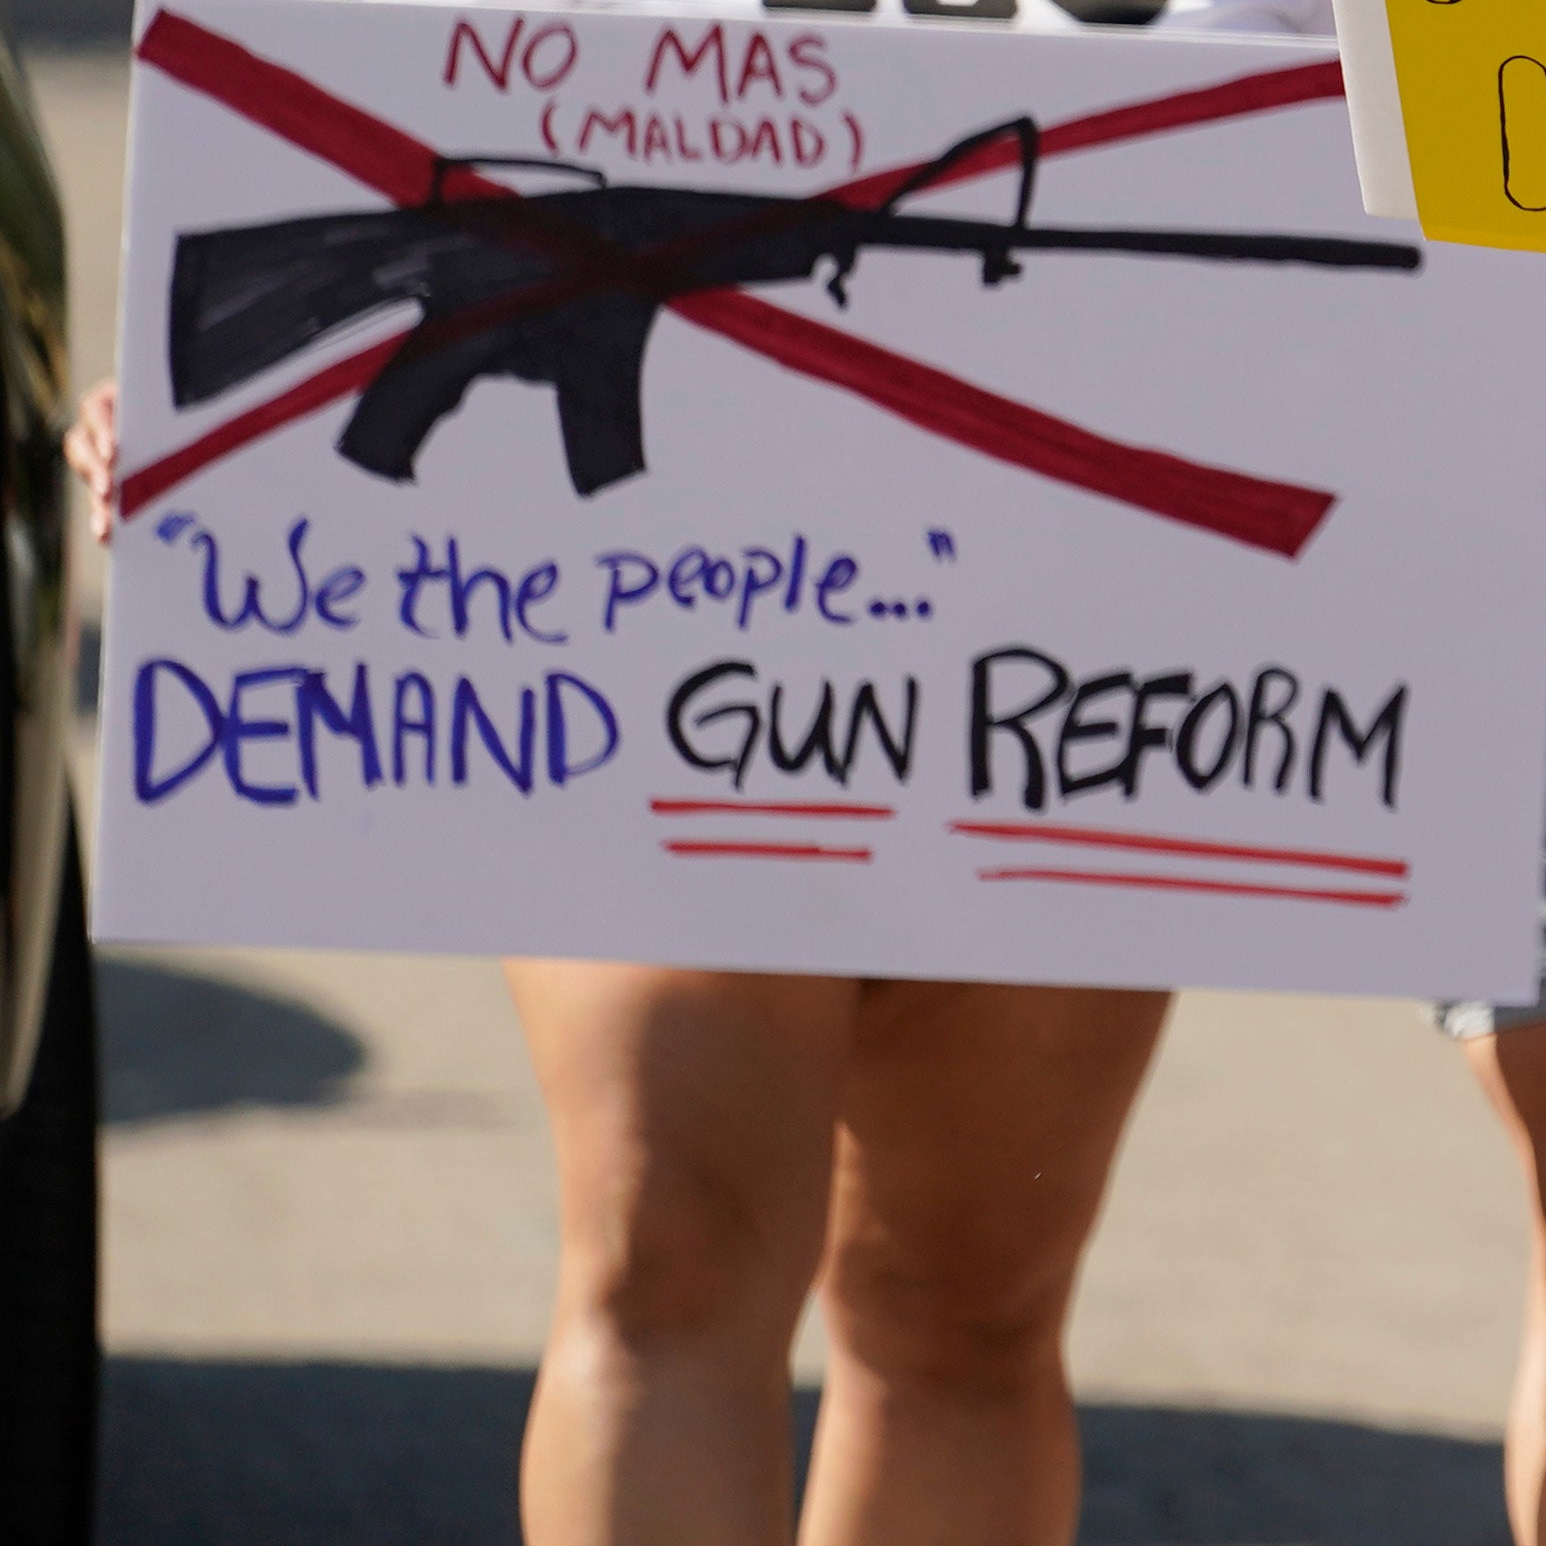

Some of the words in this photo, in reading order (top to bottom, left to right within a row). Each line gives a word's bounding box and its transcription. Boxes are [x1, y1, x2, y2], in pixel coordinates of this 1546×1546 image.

[443, 17, 577, 90] NO
[643, 21, 837, 105] MAS
[540, 97, 864, 174] (MALDAD)
[399, 535, 568, 641] the
[132, 659, 619, 805] DEMAND
[665, 661, 919, 789] GUN
[967, 647, 1409, 809] REFORM
